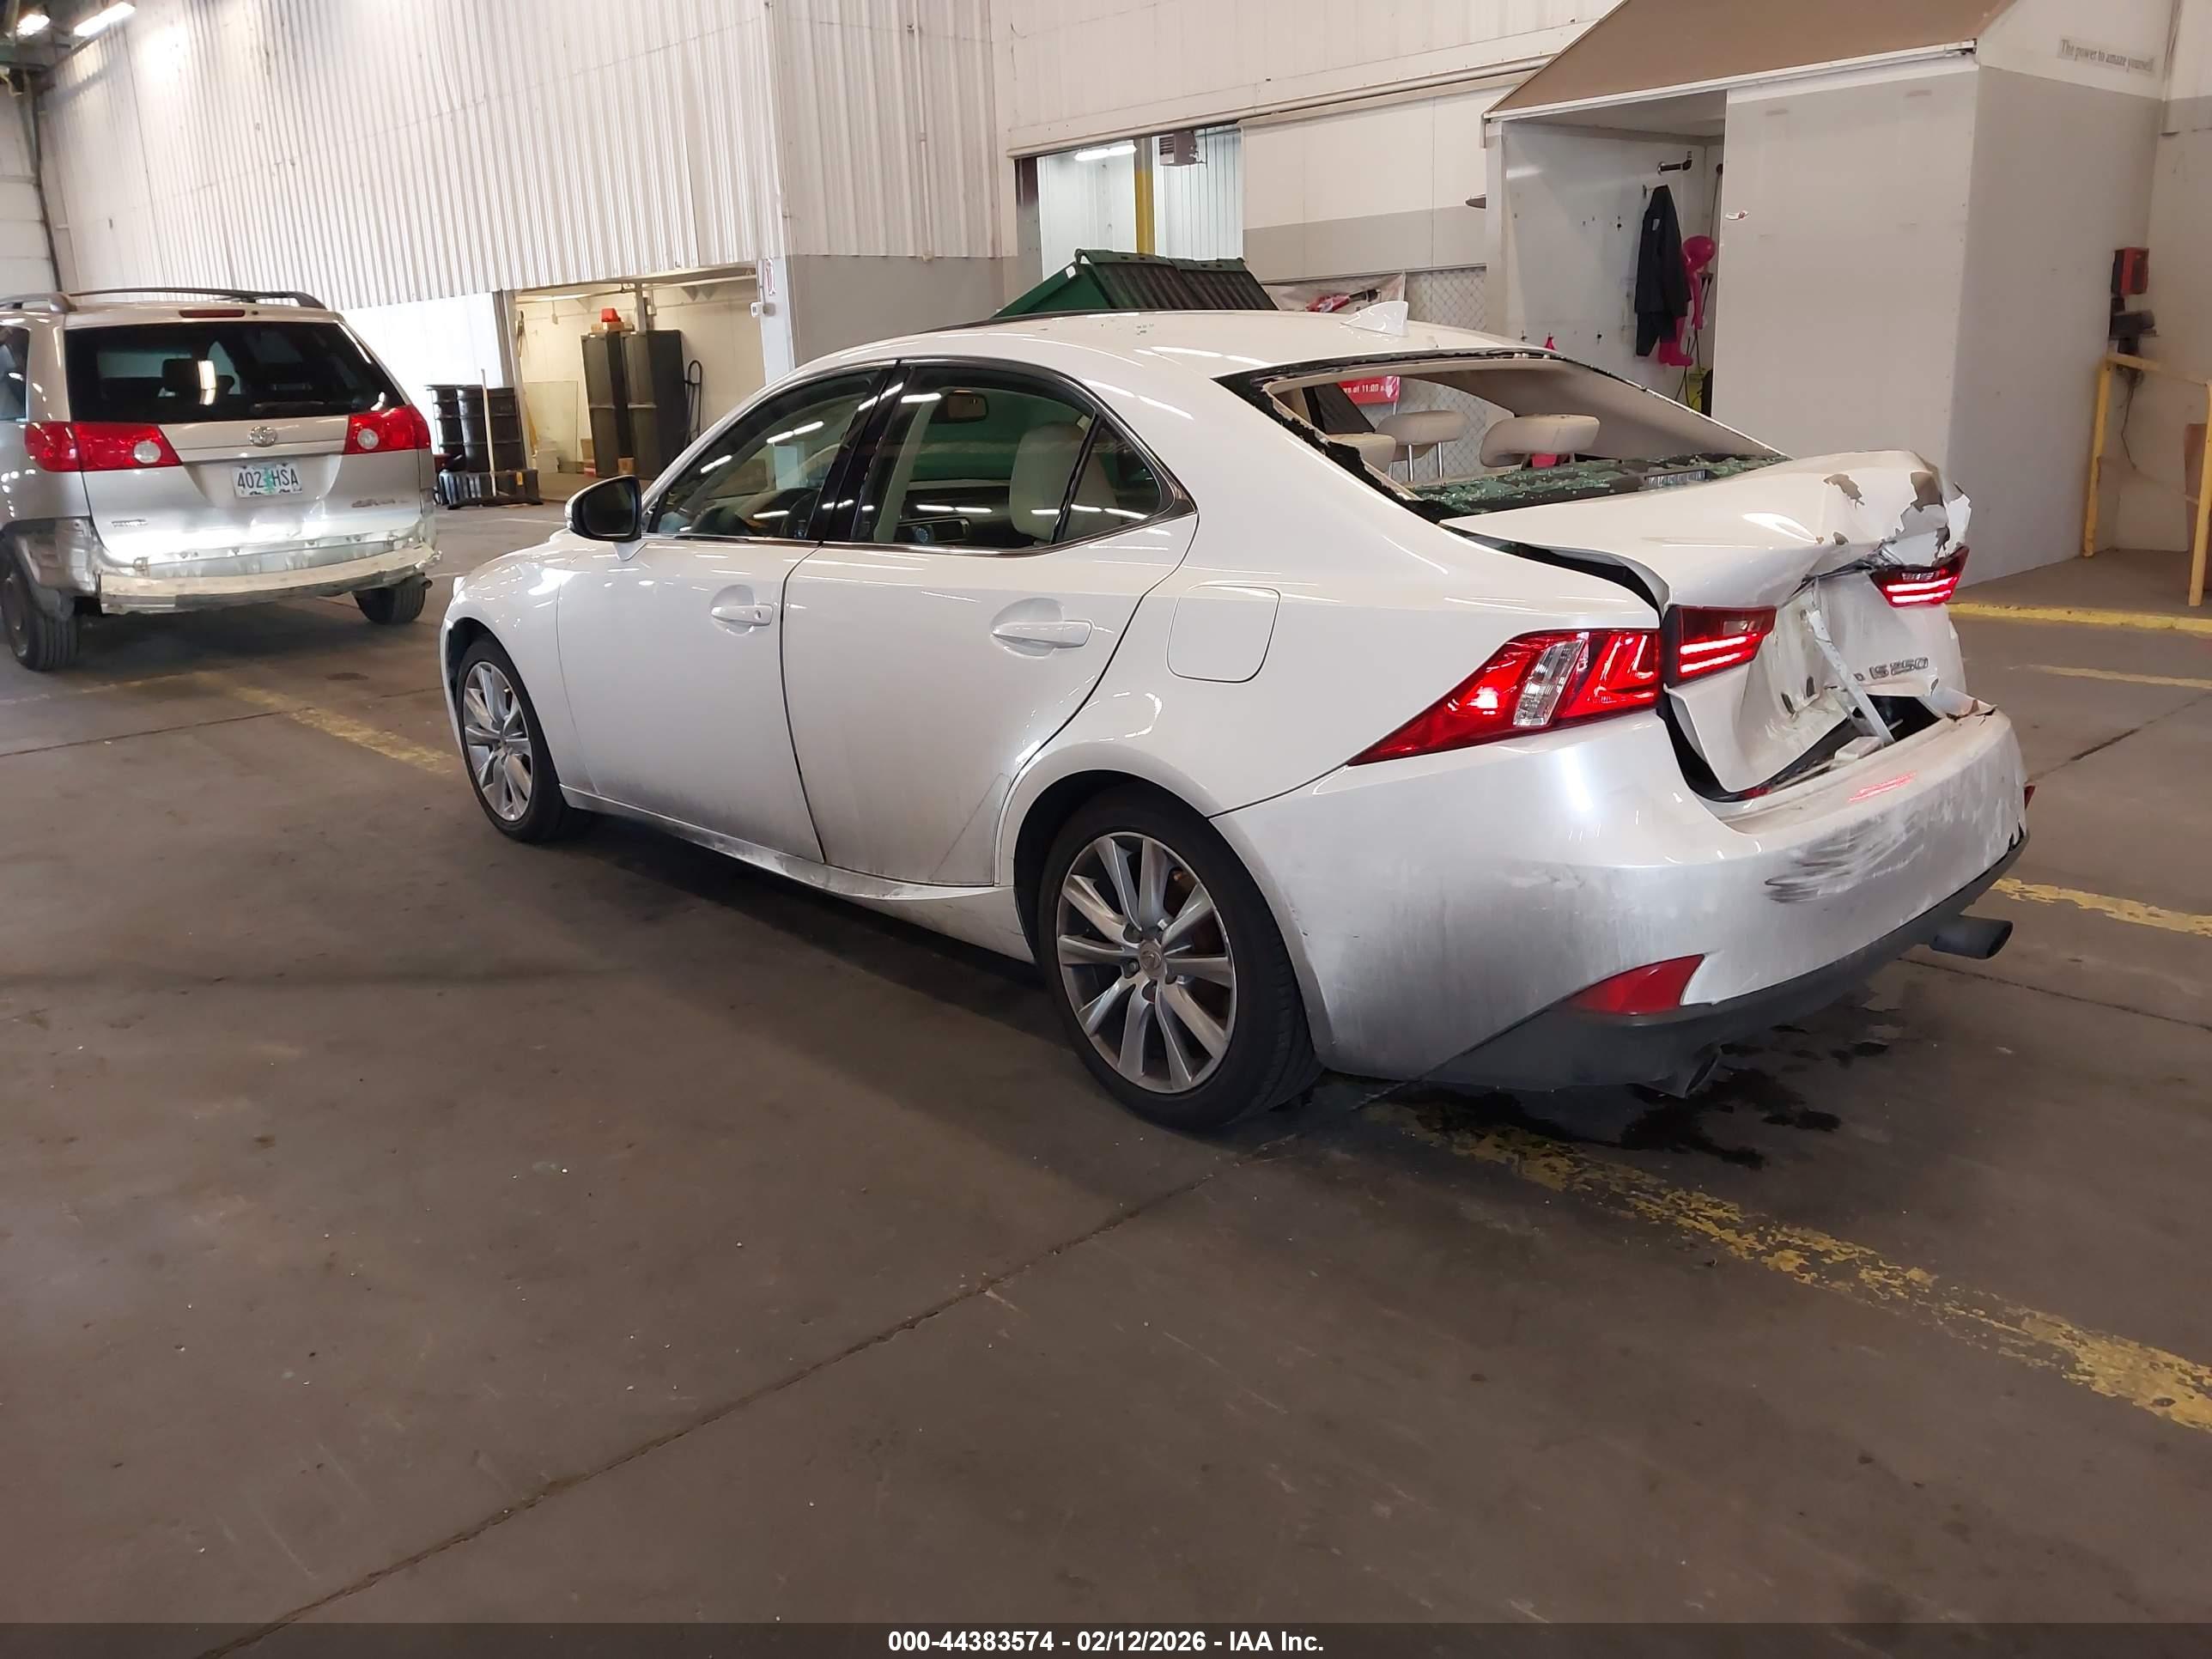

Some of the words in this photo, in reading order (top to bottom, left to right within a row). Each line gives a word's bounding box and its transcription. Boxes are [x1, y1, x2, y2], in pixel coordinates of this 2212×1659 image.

[2062, 40, 2075, 56] The
[238, 471, 264, 489] 402
[270, 468, 299, 487] HSA
